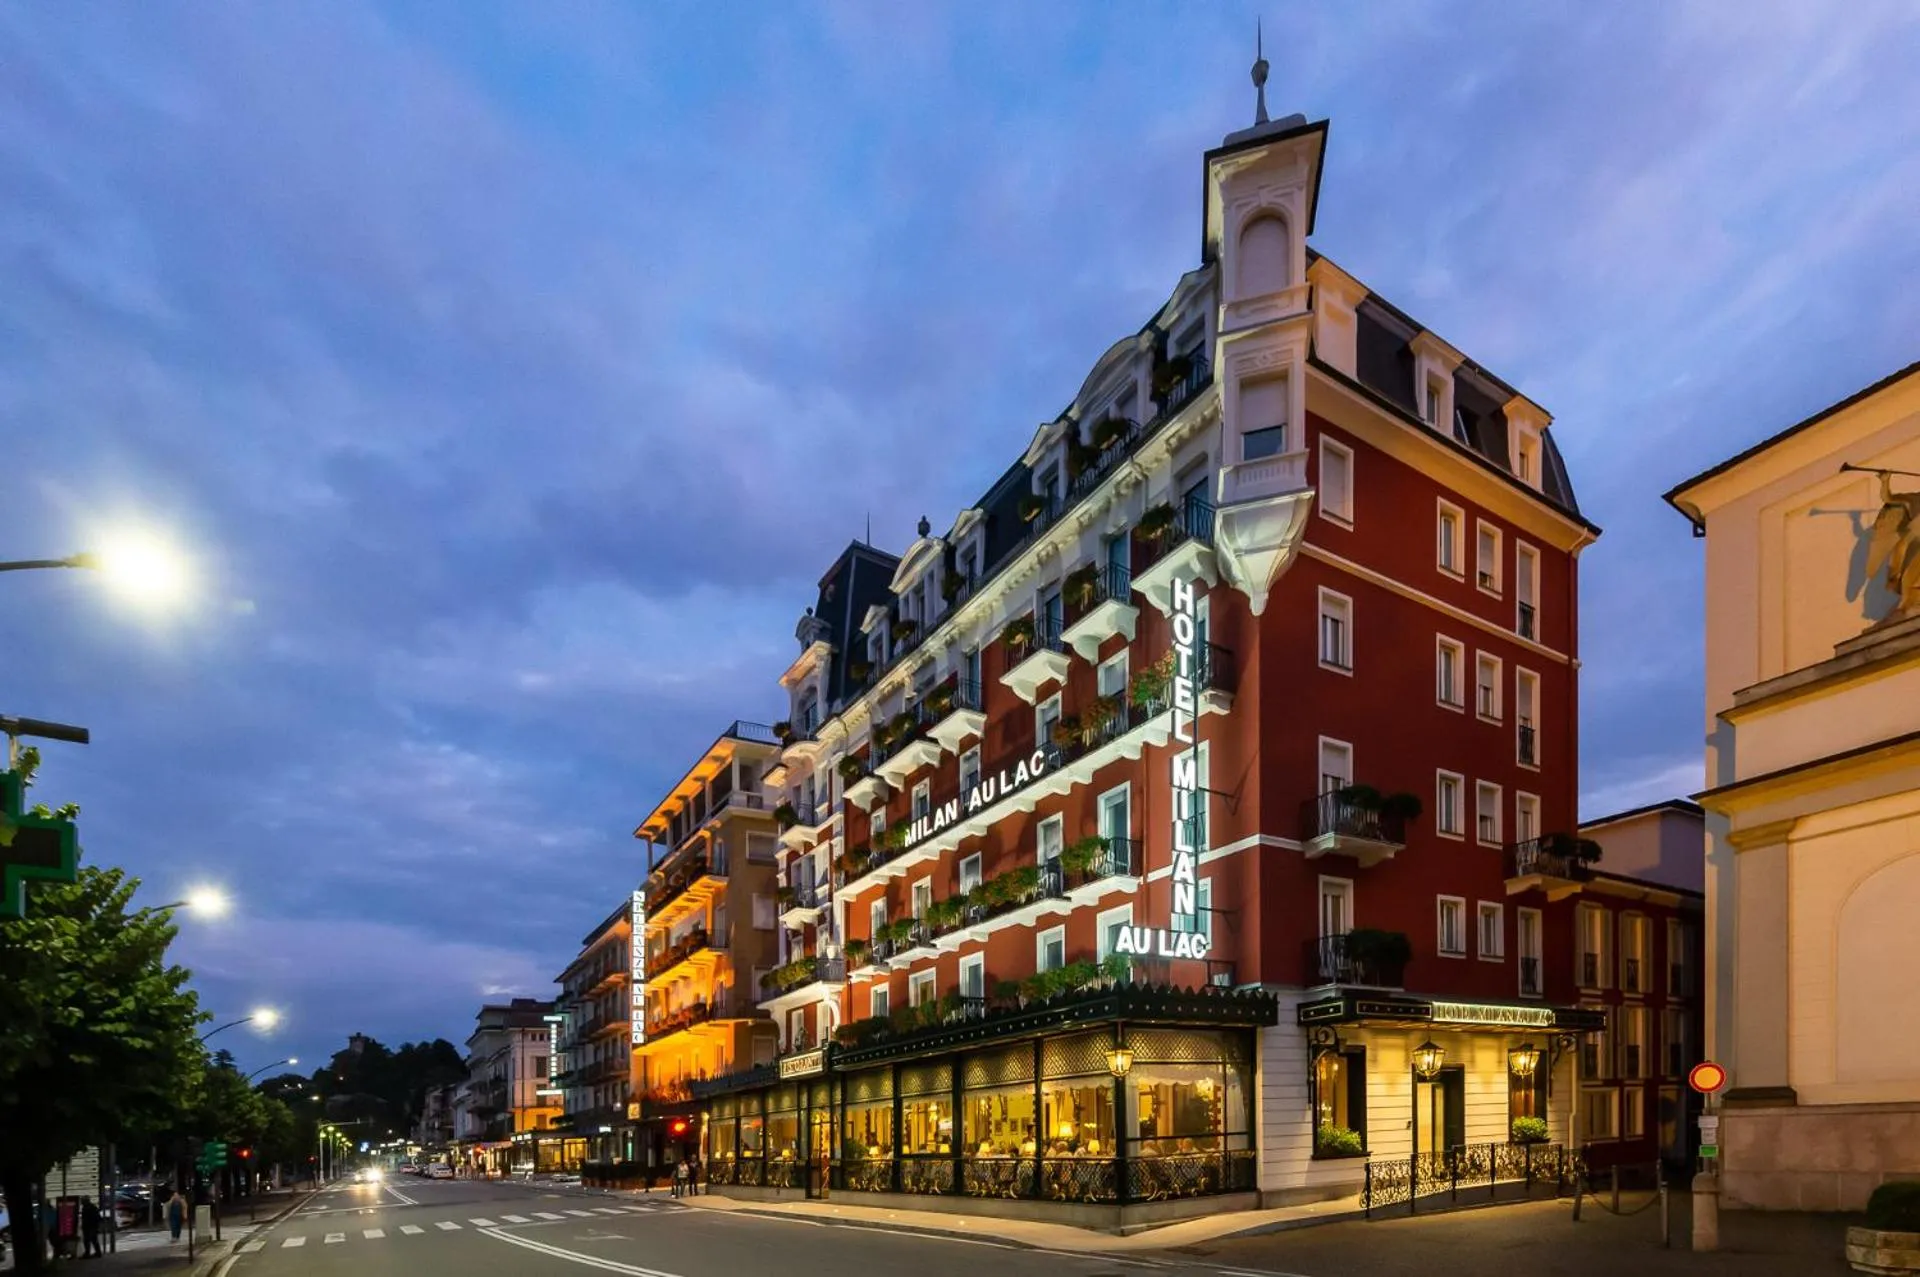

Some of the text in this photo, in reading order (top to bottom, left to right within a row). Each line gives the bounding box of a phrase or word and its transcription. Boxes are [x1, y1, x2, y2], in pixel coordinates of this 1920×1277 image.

[1173, 577, 1195, 914] HOTEL MILAN
[904, 751, 1045, 847] MILAN AU LAC
[1116, 926, 1207, 959] AU LAC
